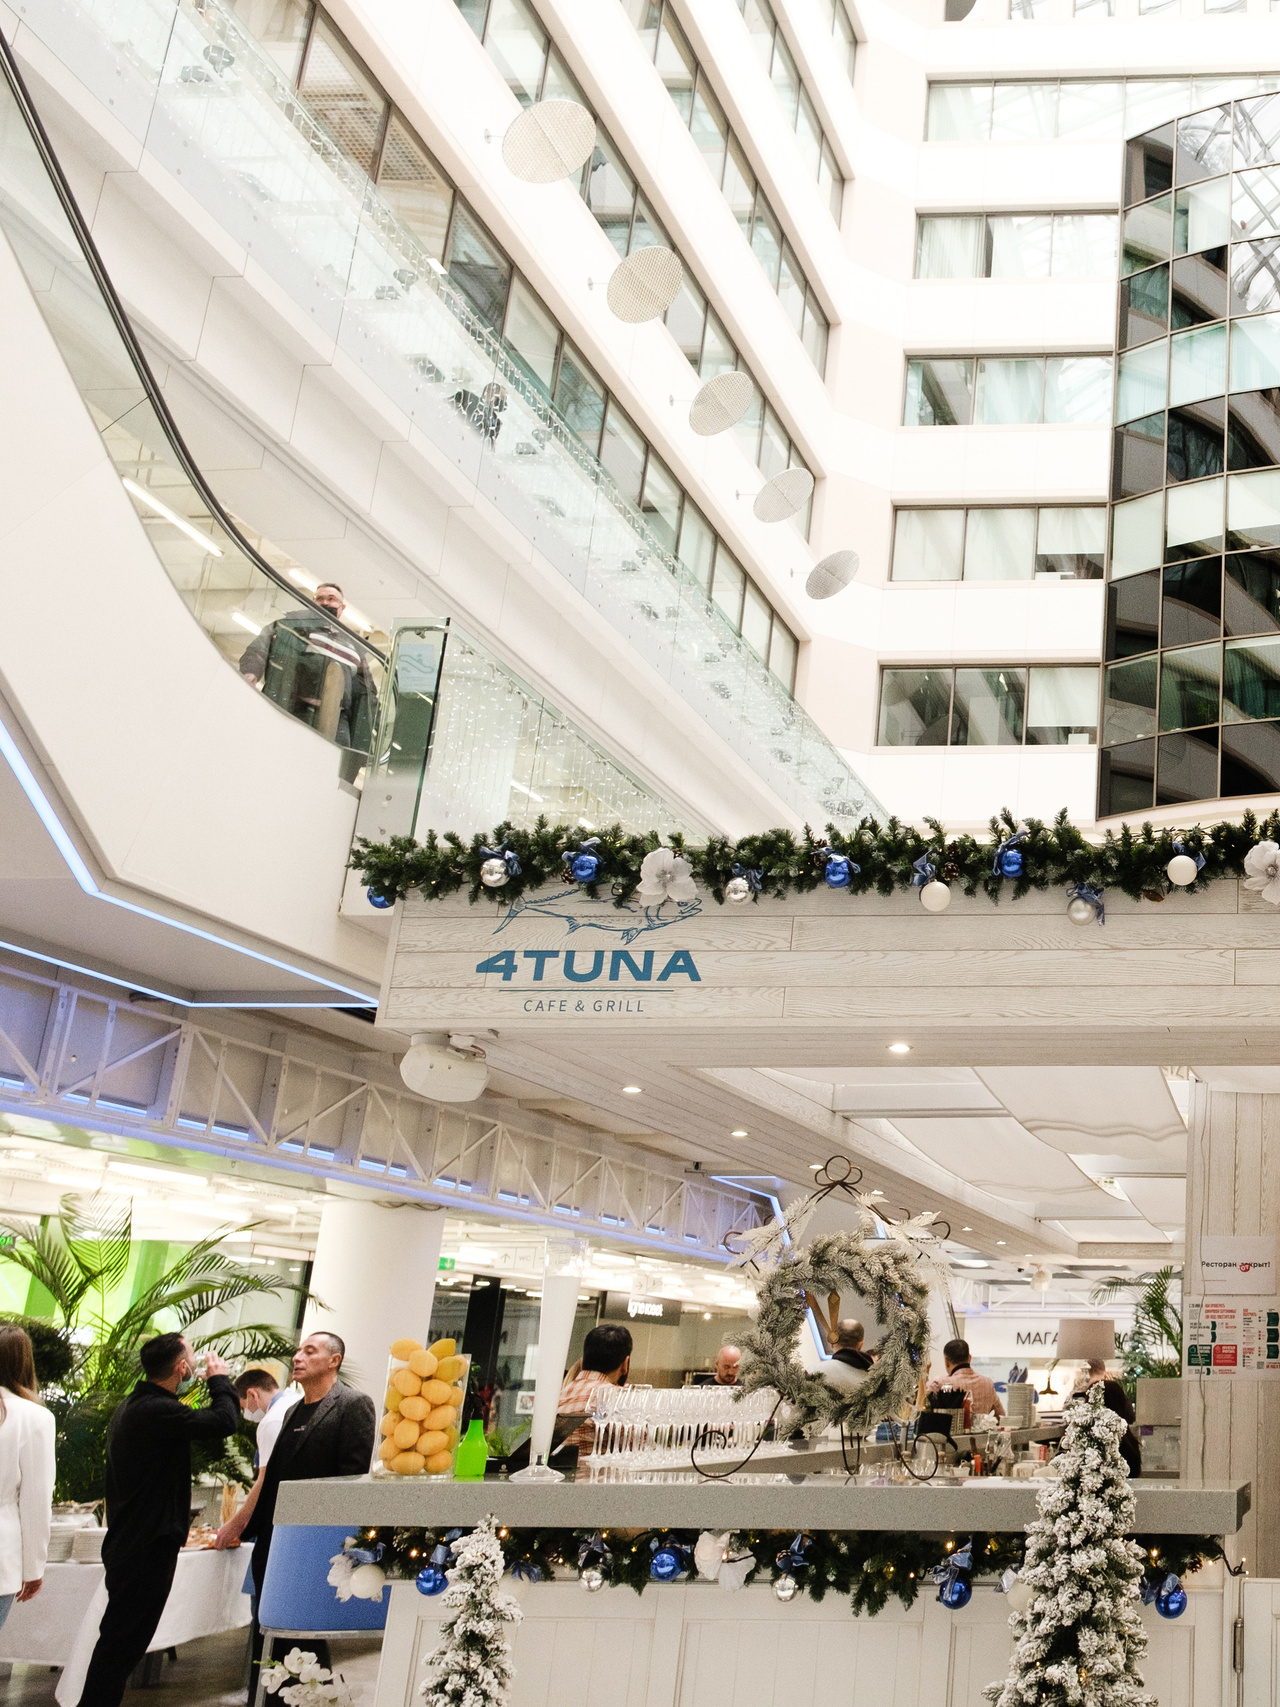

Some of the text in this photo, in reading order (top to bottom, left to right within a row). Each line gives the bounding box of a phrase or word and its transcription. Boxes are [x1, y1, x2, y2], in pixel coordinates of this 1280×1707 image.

[475, 950, 702, 982] 4TUNA
[523, 1000, 645, 1012] CAFE & GRILL
[1201, 1261, 1237, 1269] Ресторан
